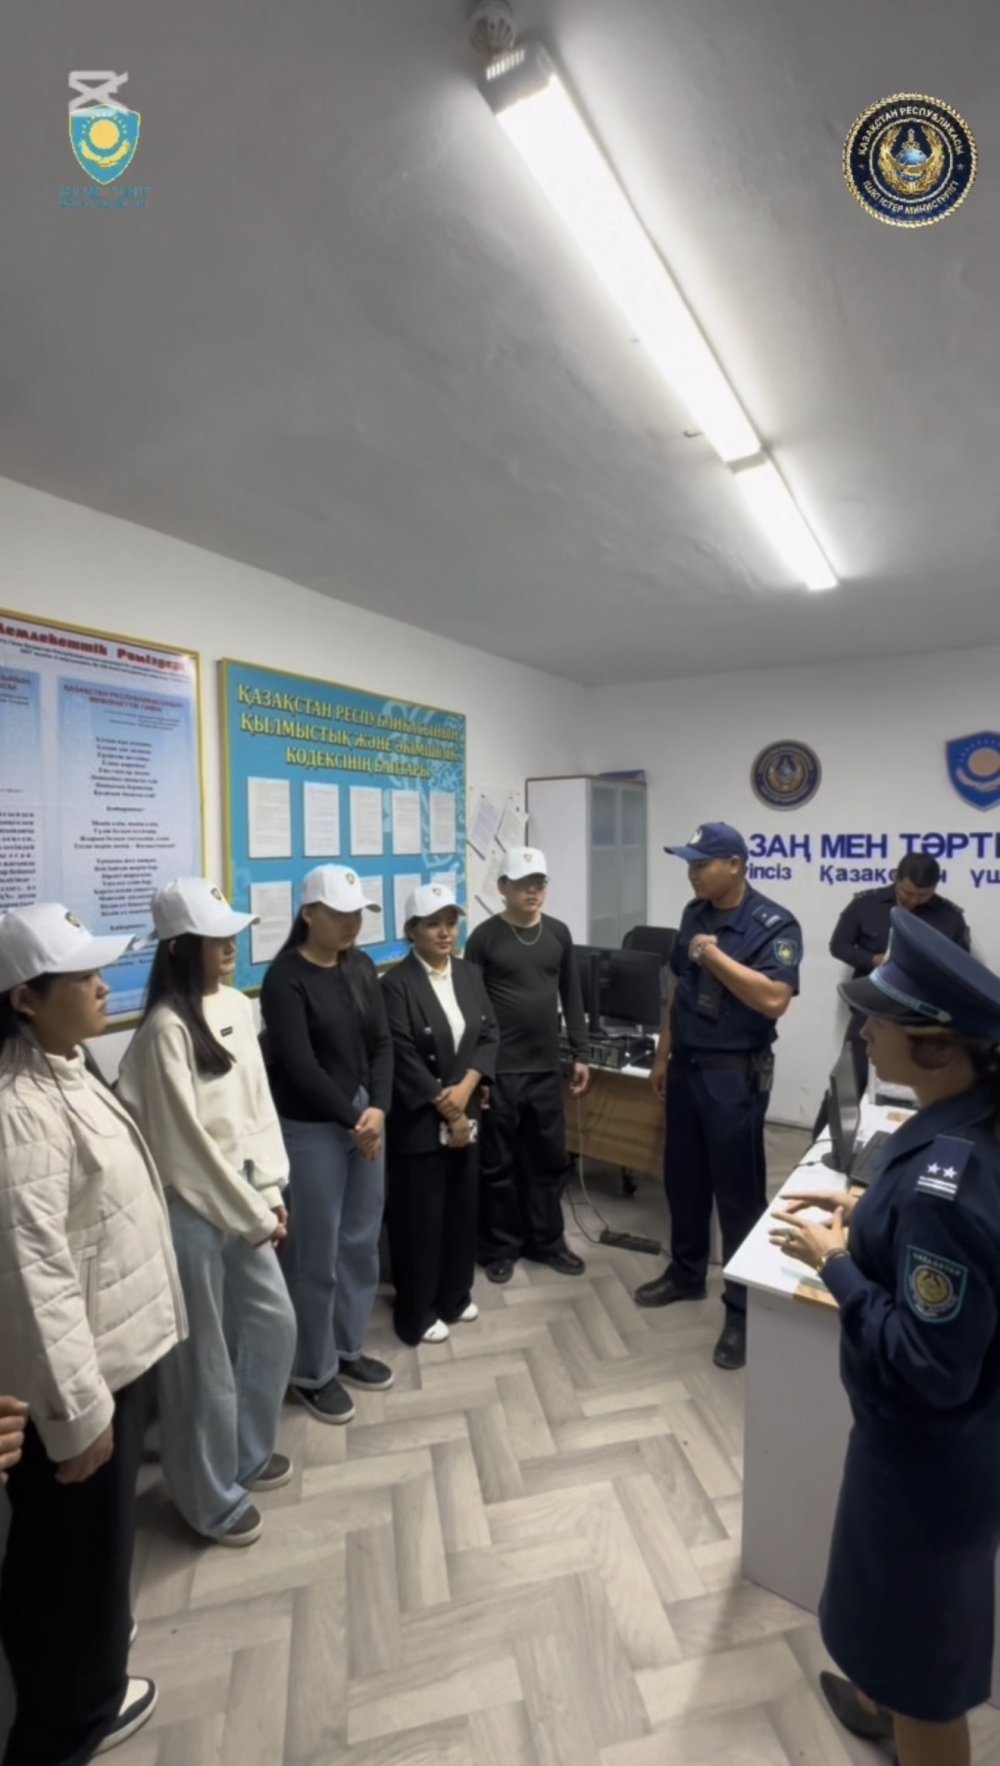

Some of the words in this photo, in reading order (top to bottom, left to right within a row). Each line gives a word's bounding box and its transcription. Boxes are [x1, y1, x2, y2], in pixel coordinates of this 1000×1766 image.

[238, 683, 332, 719] ҚАЗАҚСТАН
[240, 712, 352, 749] ҚЫЛМЫСТЫҚ
[355, 732, 392, 752] ЖӘНЕ
[286, 746, 373, 776] КОДЕКСІНІҢ
[749, 833, 811, 862] ЗАҢ
[820, 833, 888, 858] МЕН
[747, 863, 792, 880] іпсіз
